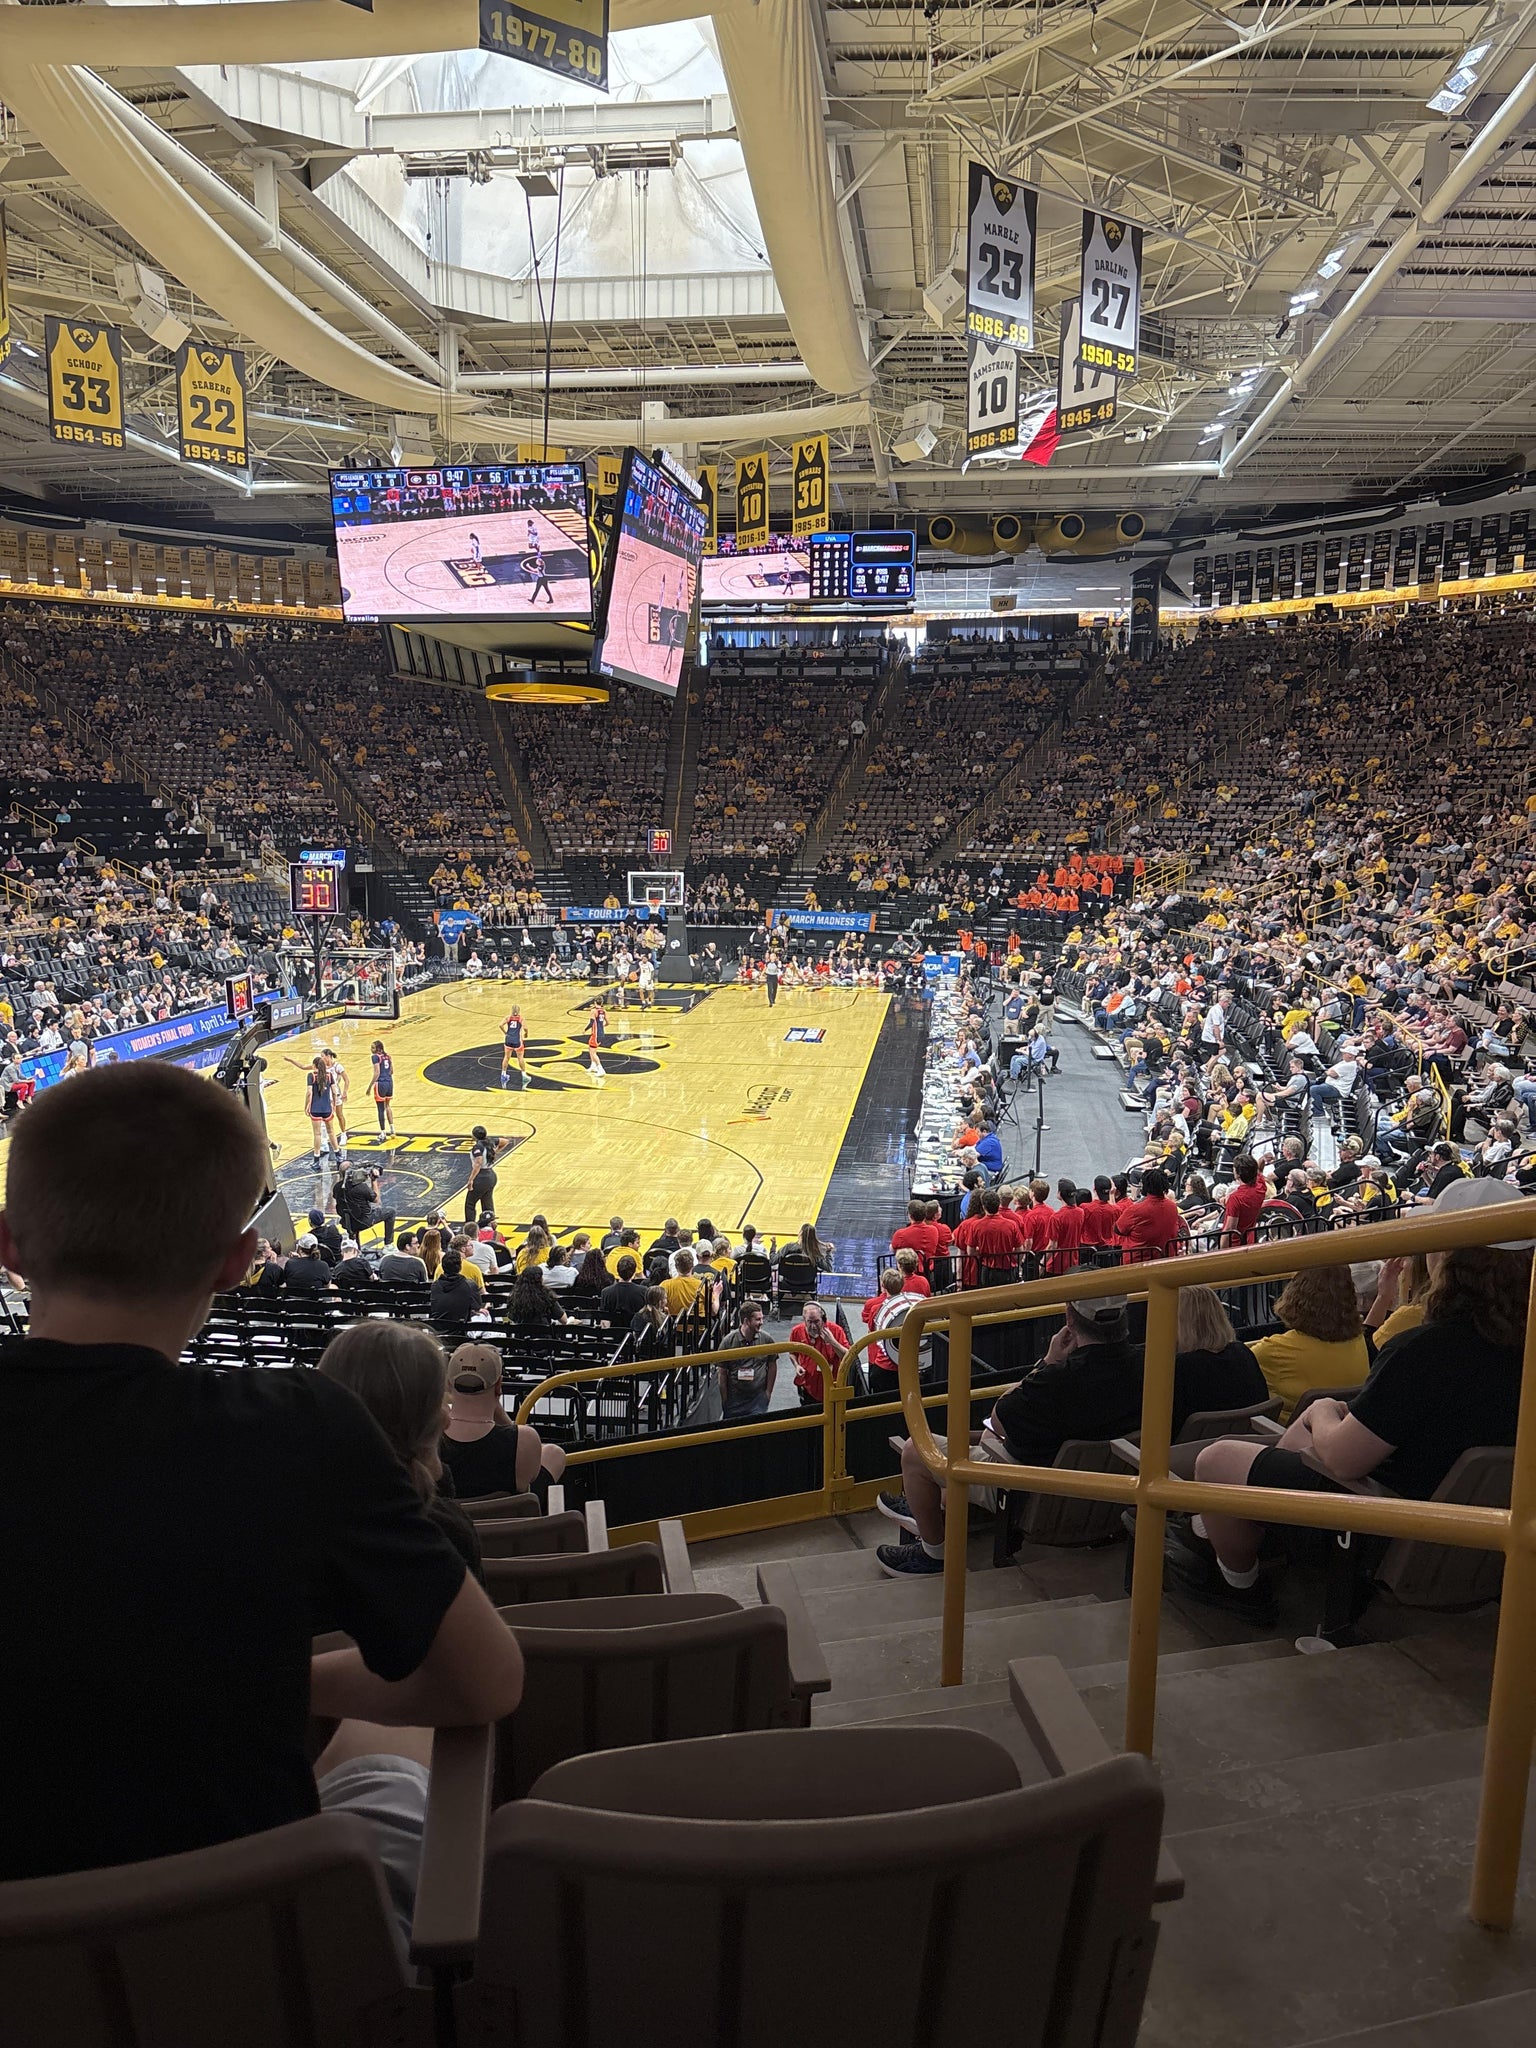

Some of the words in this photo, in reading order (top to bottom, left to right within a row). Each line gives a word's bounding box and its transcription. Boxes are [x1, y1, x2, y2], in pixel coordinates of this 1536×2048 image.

[491, 11, 601, 76] 1977-80
[984, 222, 1019, 245] MARBLE
[978, 242, 1024, 301] 23
[1094, 259, 1128, 279] DARLING
[1090, 278, 1131, 331] 27
[969, 312, 1029, 343] 1986-89
[67, 358, 103, 373] SCHOOF
[1081, 343, 1134, 373] 1950-52
[973, 361, 1014, 381] ARMSTRONG
[62, 373, 111, 415] 33
[191, 380, 231, 395] SEABERG
[978, 375, 1008, 418] 10
[190, 394, 236, 435] 22
[1060, 402, 1113, 429] 1945-48
[54, 424, 123, 447] 1954-56
[968, 427, 1016, 452] 1986-89
[183, 443, 246, 465] 1954-56
[426, 474, 437, 484] 59
[447, 470, 464, 482] 9:47
[489, 472, 501, 483] 56
[519, 475, 524, 483] 0
[531, 475, 536, 483] 3
[797, 477, 822, 510] 30
[742, 492, 761, 523] 10
[794, 516, 826, 533] 1985-88
[738, 530, 766, 546] 2016-19
[855, 575, 866, 584] 59
[874, 575, 889, 584] 9:47
[898, 574, 908, 584] 56
[346, 615, 379, 624] Traveling
[653, 838, 667, 851] 30
[309, 852, 333, 860] MARCH
[304, 869, 333, 882] 9:47
[301, 883, 330, 908] 30
[588, 908, 612, 918] FOUR
[613, 908, 624, 918] IT
[788, 914, 815, 925] MARCH
[816, 915, 855, 927] MADNESS
[130, 1032, 163, 1053] WOMEN'S
[160, 1029, 179, 1045] FINAL
[178, 1023, 195, 1039] FOUR
[199, 1014, 218, 1033] April
[218, 1013, 226, 1027] 3
[509, 1020, 517, 1029] 21
[384, 1060, 389, 1070] 5
[998, 1494, 1007, 1511] J
[1337, 1530, 1352, 1549] J
